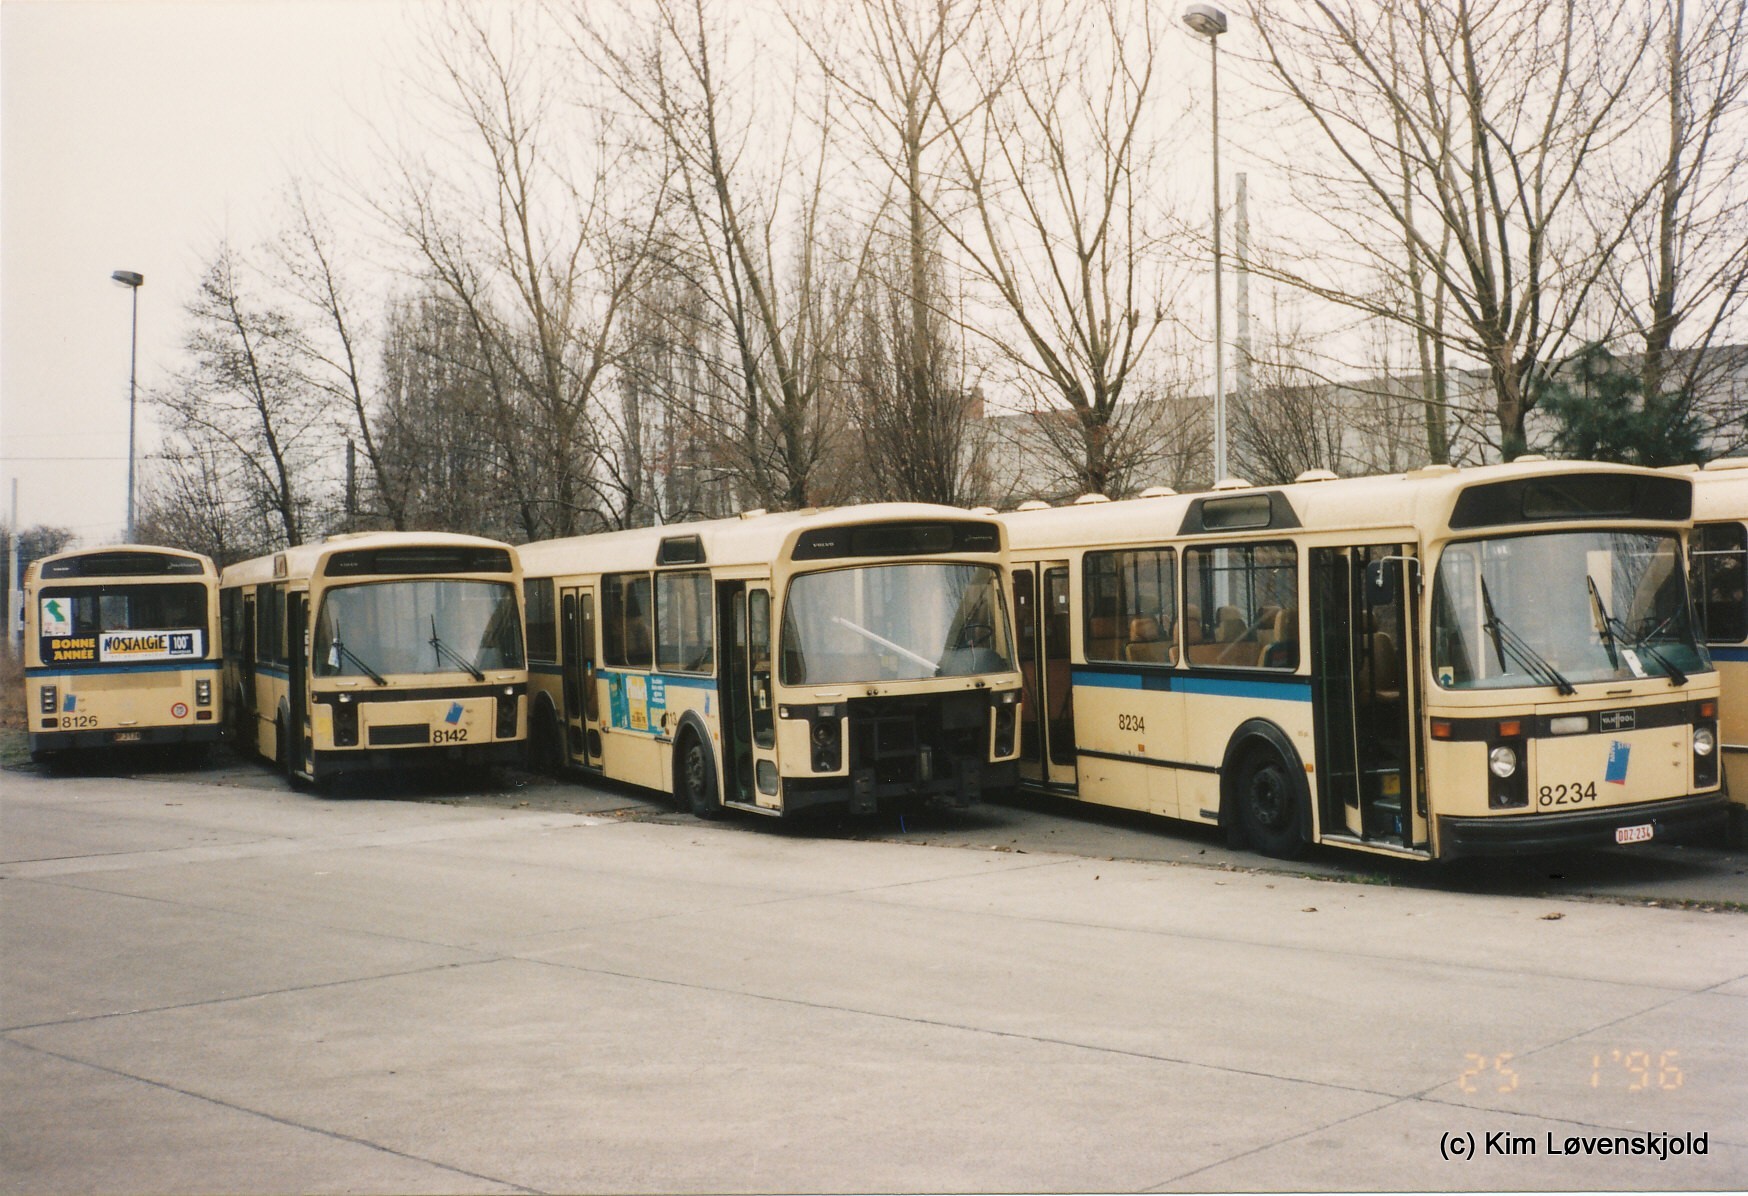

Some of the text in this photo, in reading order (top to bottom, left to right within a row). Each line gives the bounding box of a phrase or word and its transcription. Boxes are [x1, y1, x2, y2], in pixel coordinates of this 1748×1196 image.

[52, 638, 96, 649] BONNE
[62, 716, 98, 729] 8126
[1119, 713, 1145, 734] 8234
[433, 729, 468, 744] 8142
[1539, 781, 1597, 807] 8234
